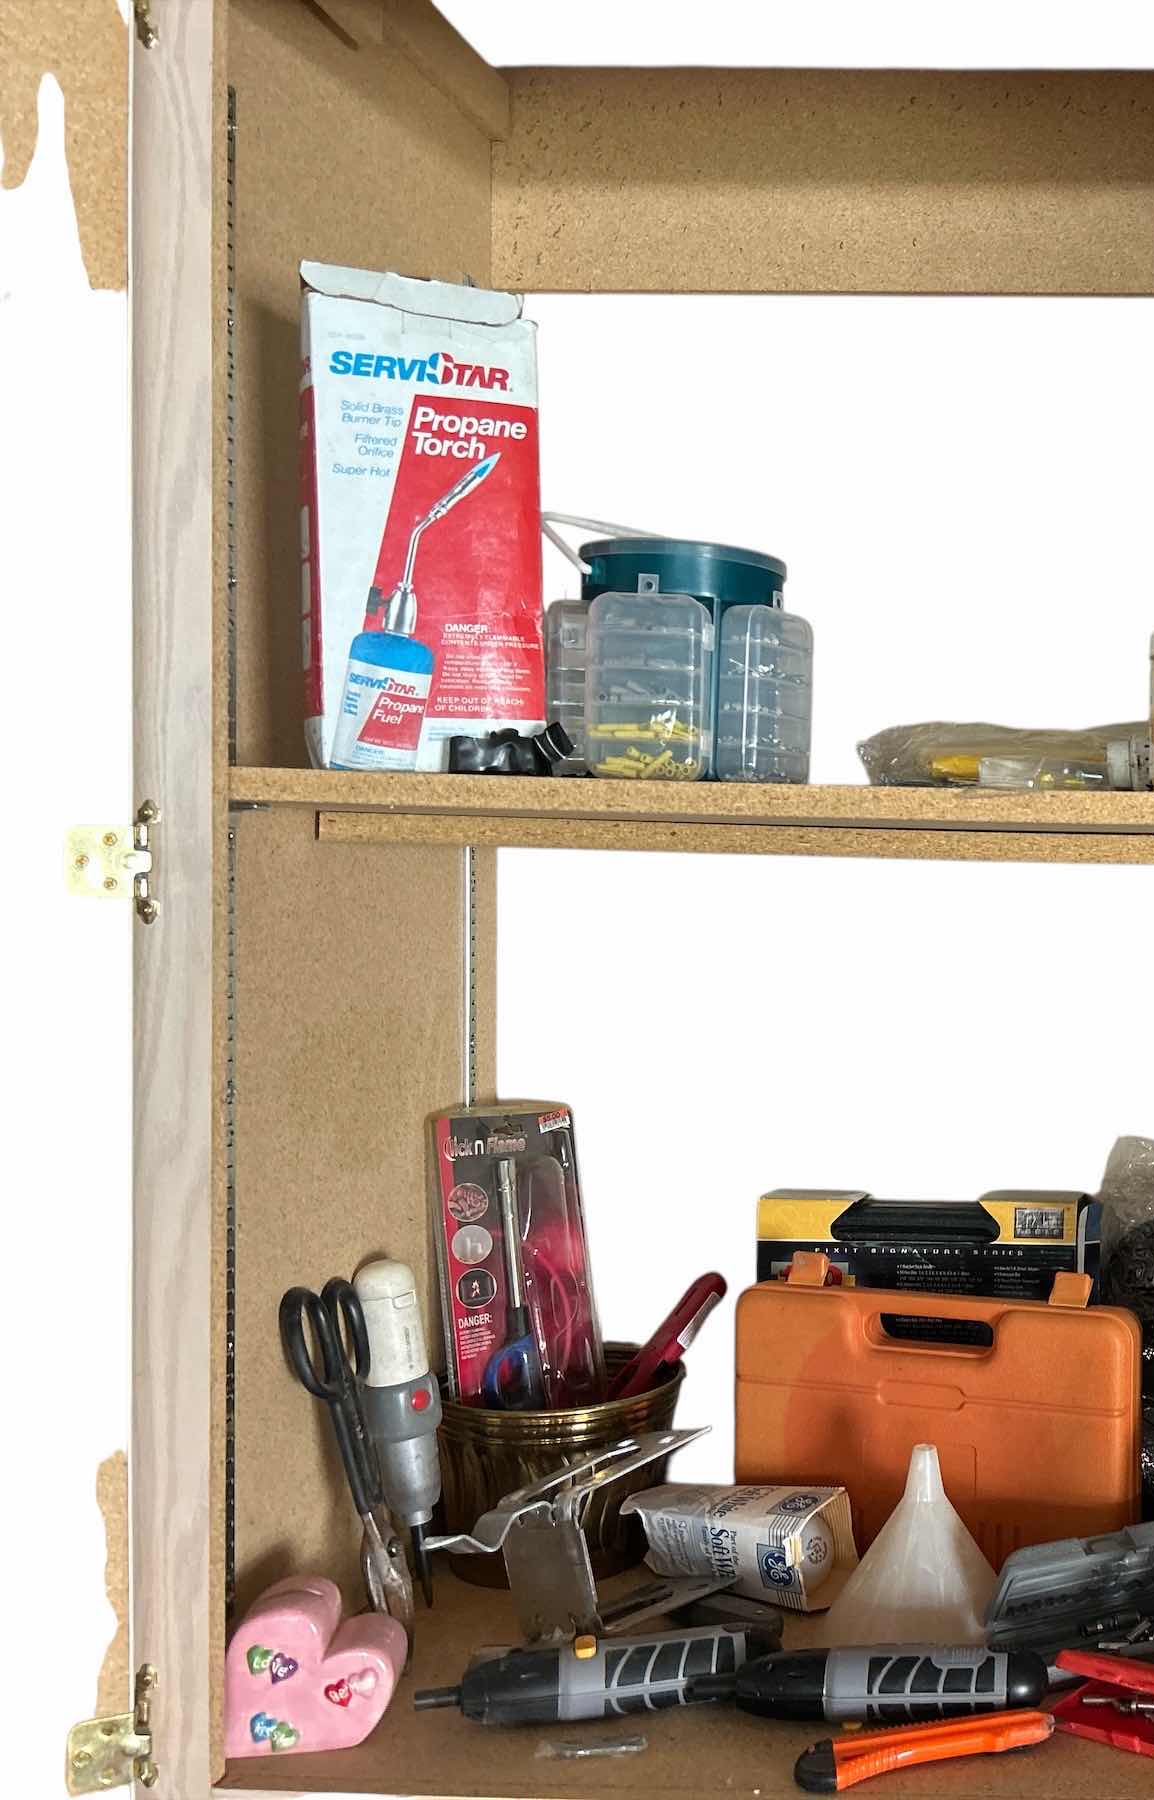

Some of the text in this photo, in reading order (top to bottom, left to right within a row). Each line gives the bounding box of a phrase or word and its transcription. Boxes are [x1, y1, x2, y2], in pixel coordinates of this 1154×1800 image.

[340, 400, 404, 416] Solid Brass
[341, 413, 401, 428] Burner Tip
[413, 406, 528, 439] Propane
[354, 433, 397, 446] Filtered
[412, 431, 485, 460] Torch
[358, 445, 394, 458] Orifice
[332, 463, 390, 477] Super Hot
[437, 696, 462, 704] KEEP
[372, 709, 403, 725] Fuel
